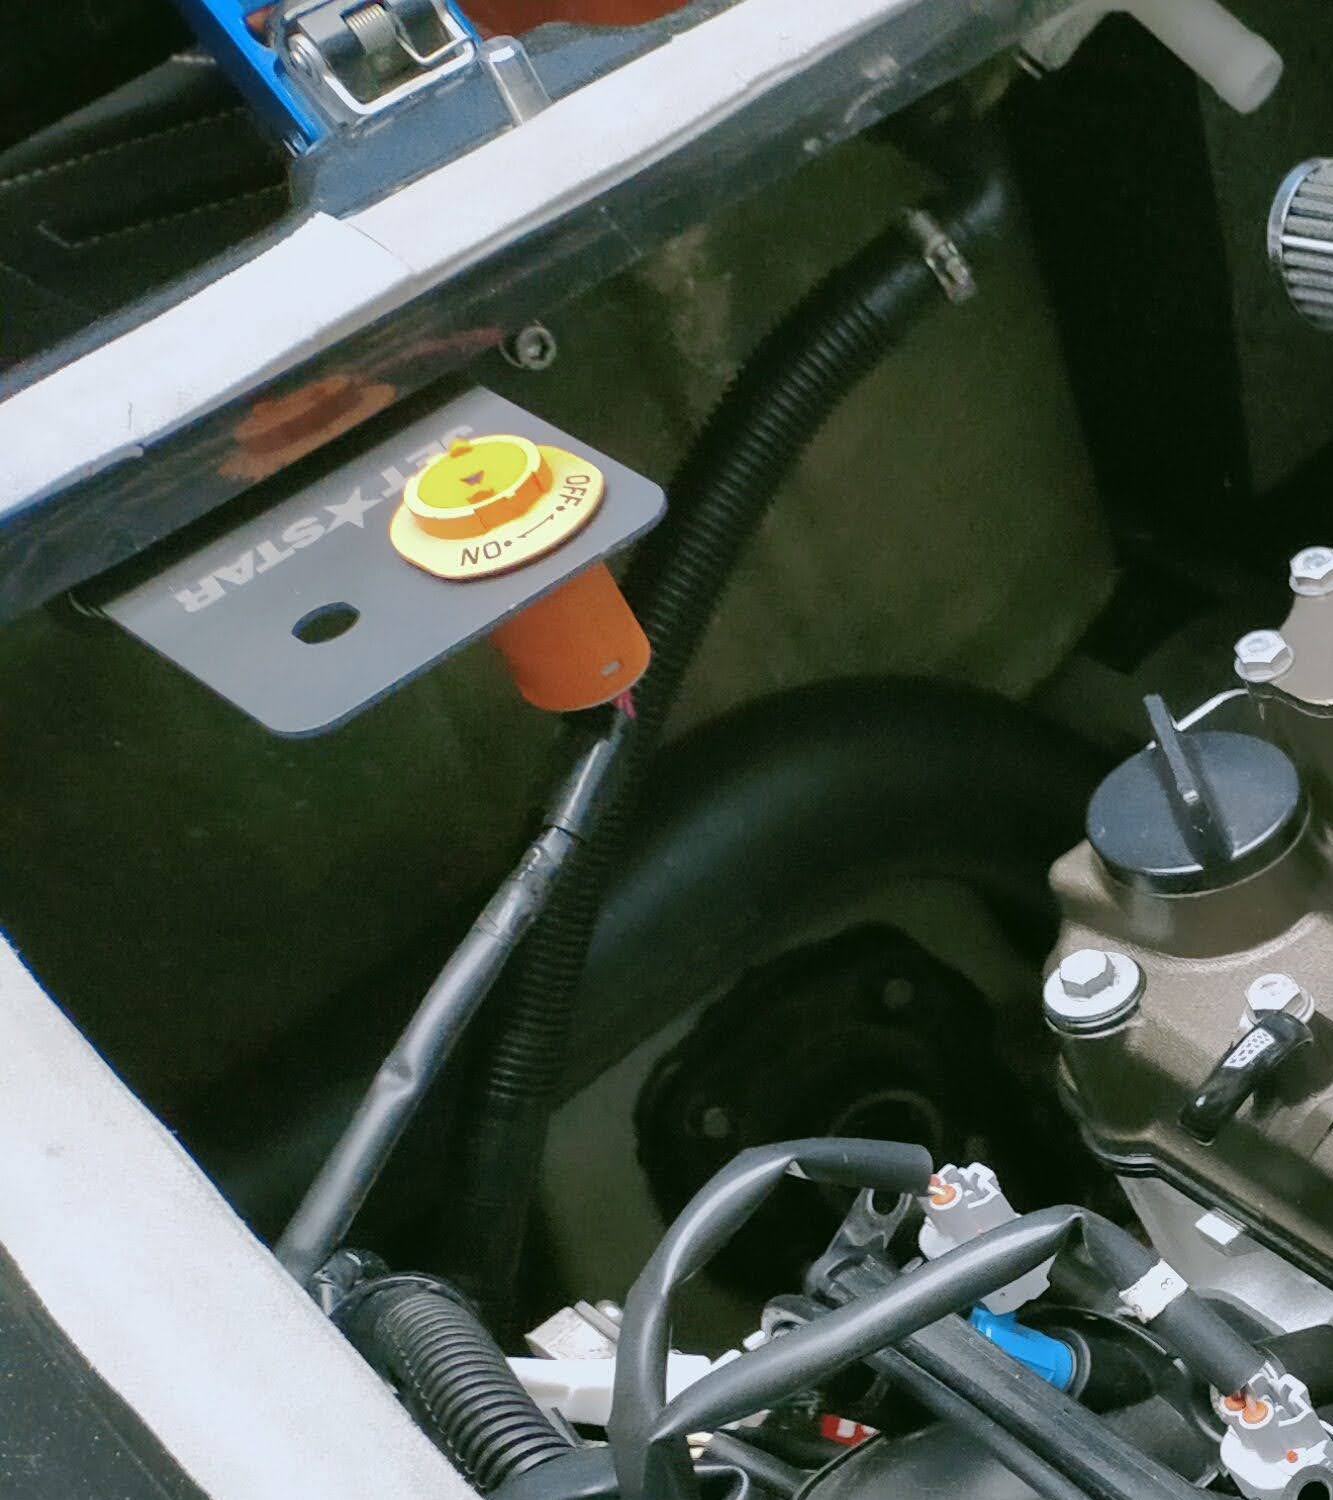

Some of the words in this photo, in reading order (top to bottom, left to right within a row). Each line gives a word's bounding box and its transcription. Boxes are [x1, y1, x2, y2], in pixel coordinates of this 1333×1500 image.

[559, 475, 591, 507] OFF
[175, 516, 326, 612] STAR
[460, 541, 502, 567] ON
